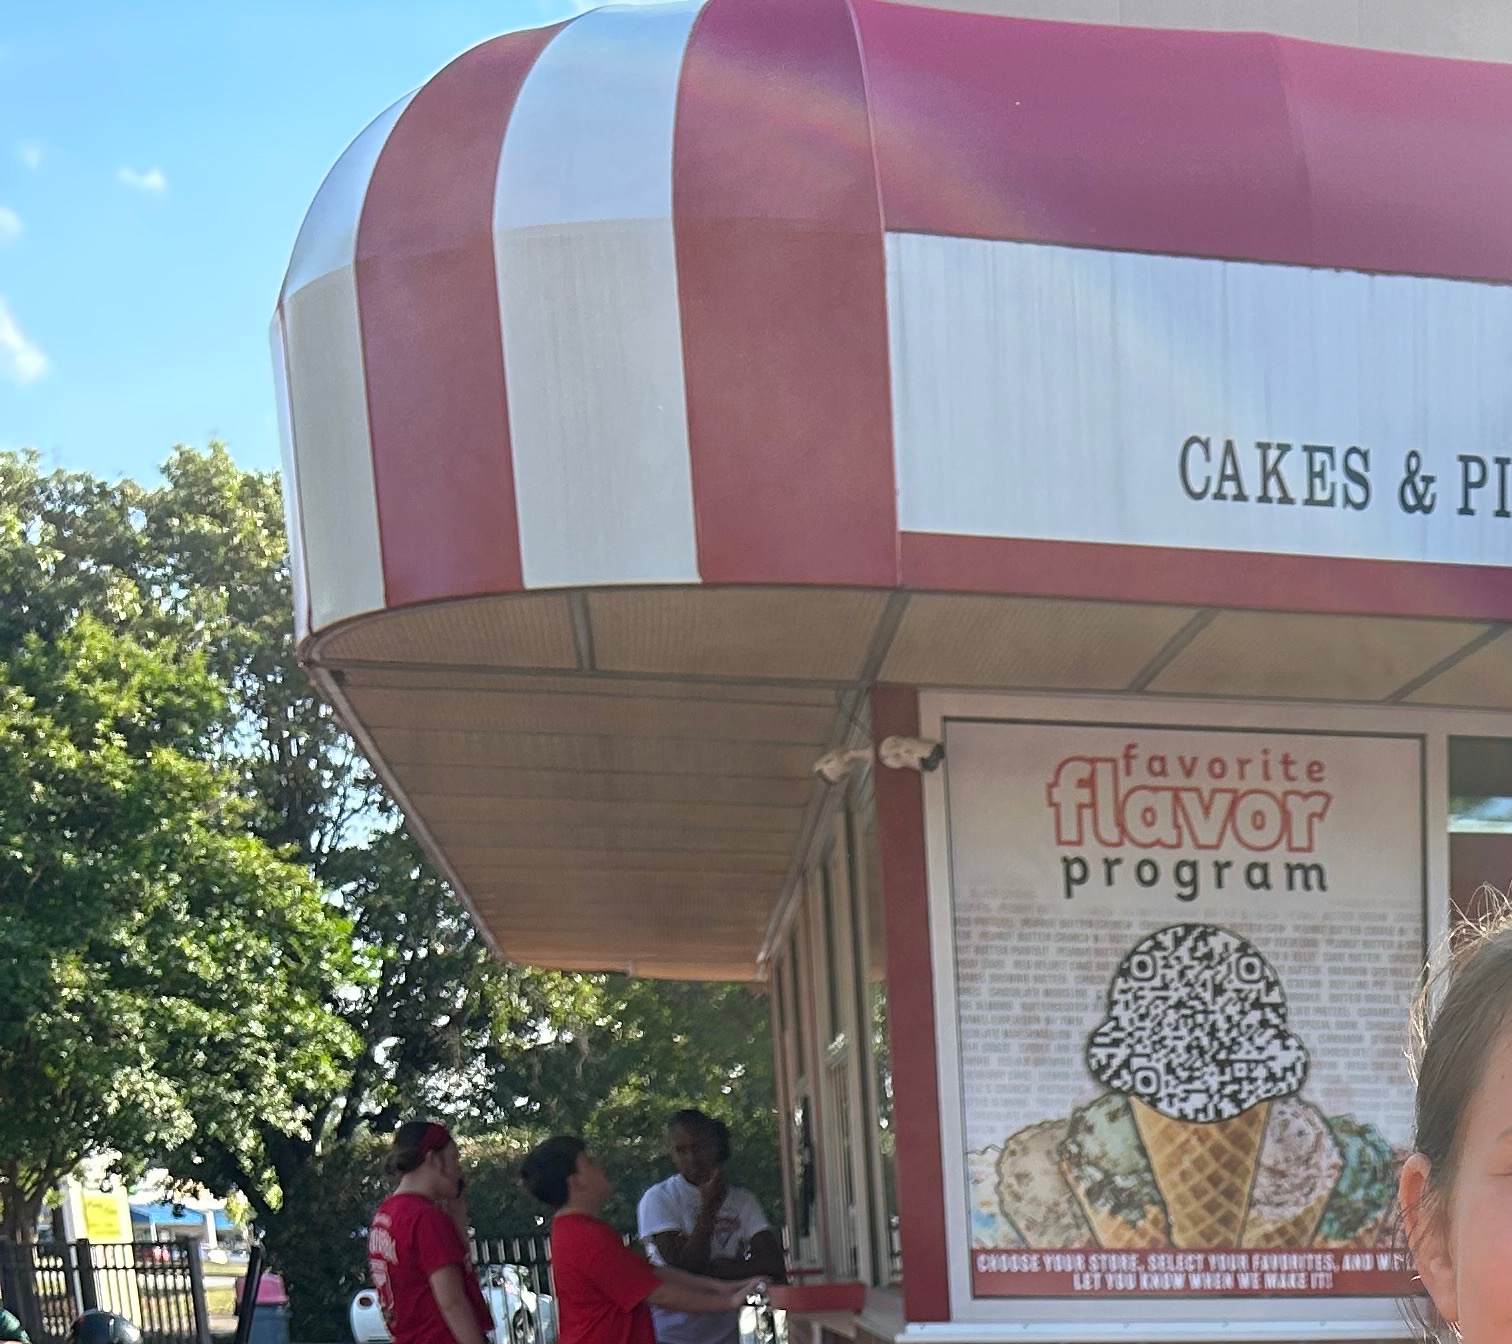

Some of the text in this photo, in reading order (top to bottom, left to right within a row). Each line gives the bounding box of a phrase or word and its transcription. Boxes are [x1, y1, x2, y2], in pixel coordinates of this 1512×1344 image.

[1179, 435, 1371, 513] CAKES
[1399, 450, 1436, 515] &
[1123, 742, 1326, 782] favorite
[1046, 755, 1333, 853] flavor
[1061, 855, 1329, 902] program
[976, 1253, 1041, 1272] CHOOSE
[1042, 1253, 1086, 1272] YOUR
[1147, 1253, 1204, 1272] SELECT
[1207, 1253, 1249, 1272] YOUR
[1341, 1253, 1374, 1272] AND
[1073, 1272, 1101, 1290] LET
[1105, 1272, 1137, 1290] YOU
[1139, 1272, 1186, 1290] KNOW
[1189, 1272, 1235, 1290] WHEN
[1237, 1272, 1262, 1290] WE
[1264, 1272, 1308, 1290] MAKE
